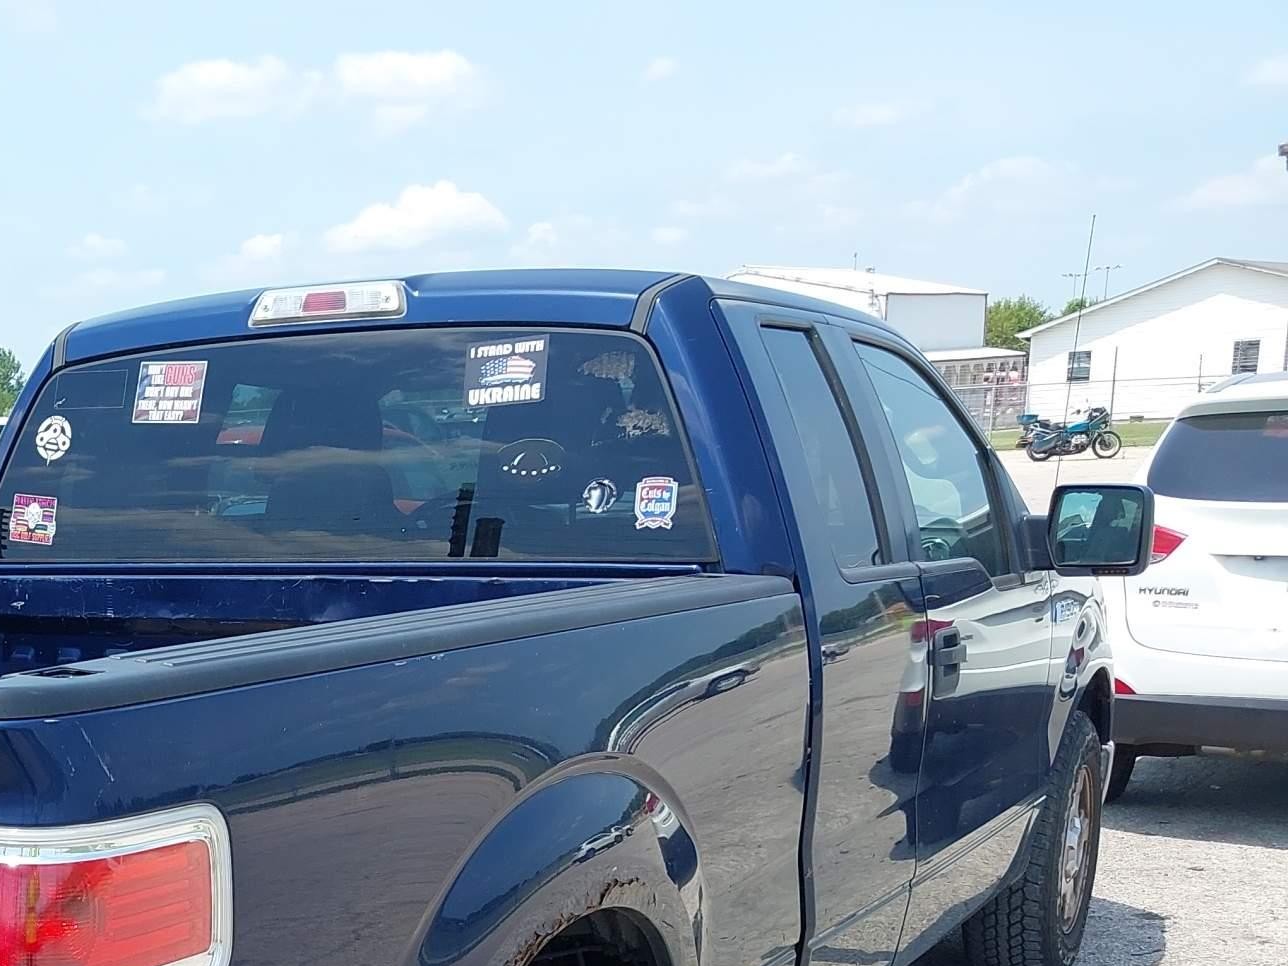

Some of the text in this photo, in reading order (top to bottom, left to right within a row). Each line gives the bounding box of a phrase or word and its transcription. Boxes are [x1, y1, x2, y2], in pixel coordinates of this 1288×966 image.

[477, 343, 513, 358] STAND
[514, 340, 545, 354] WITH
[165, 365, 196, 385] GUNS
[468, 383, 541, 405] UKRAINE
[1138, 586, 1190, 597] HYUNDAI
